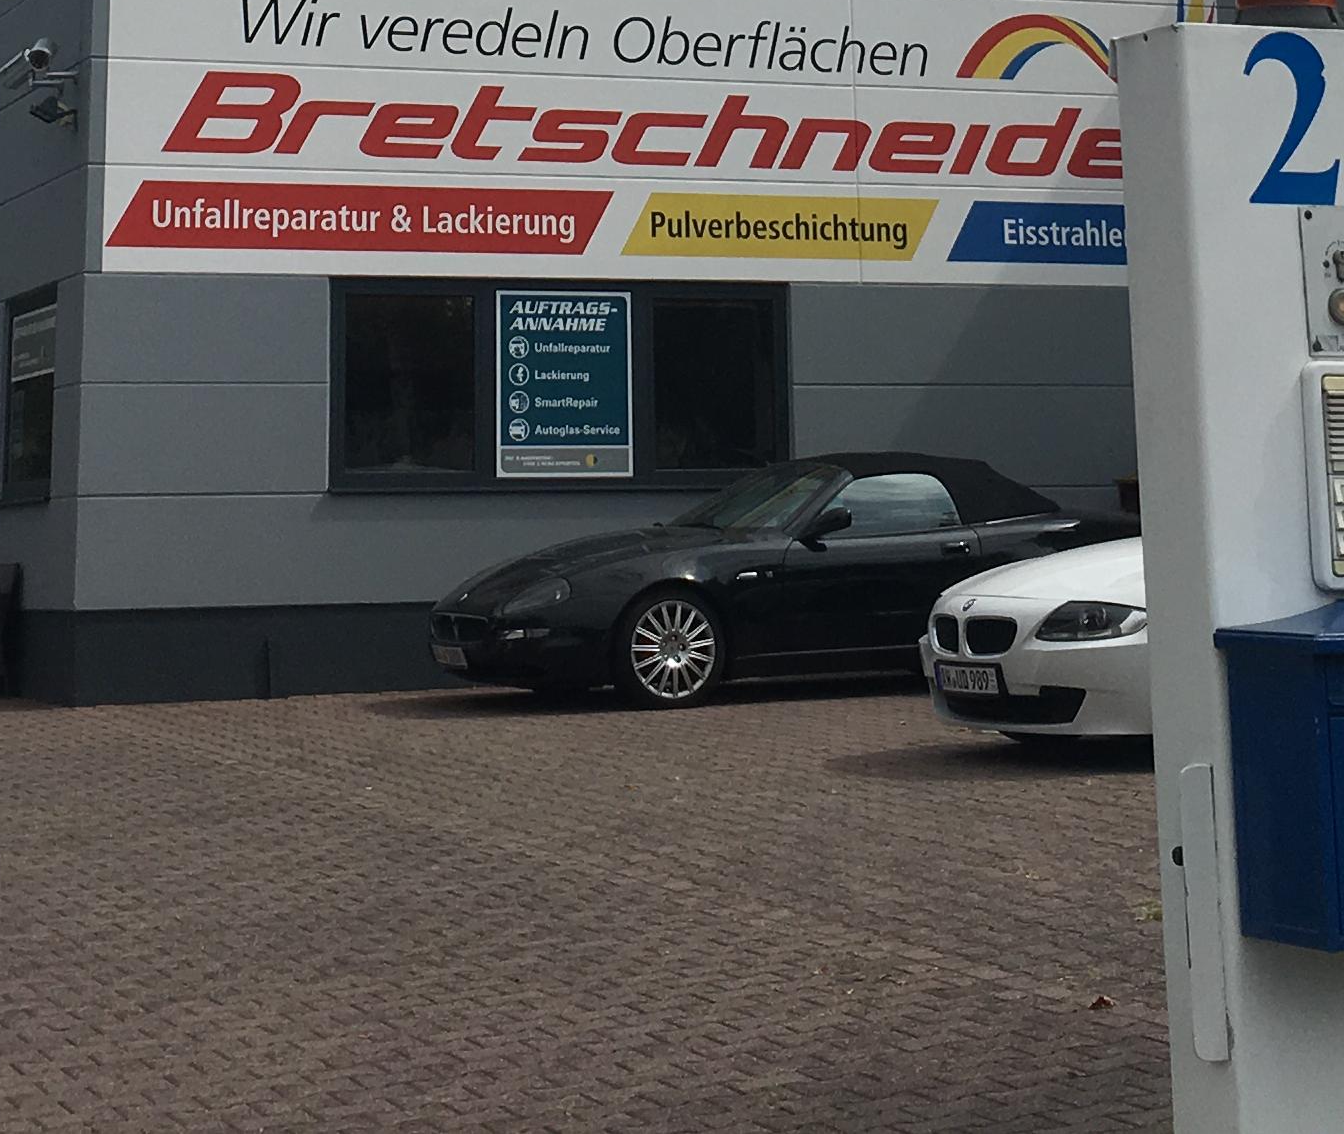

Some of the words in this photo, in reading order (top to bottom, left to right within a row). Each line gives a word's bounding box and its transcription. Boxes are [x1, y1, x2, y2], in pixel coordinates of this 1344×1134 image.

[360, 7, 589, 60] veredeln
[613, 16, 929, 77] Oberflächen
[161, 70, 1124, 179] Bretschneide
[151, 199, 380, 237] Unfallreparatur
[391, 205, 412, 234] &
[422, 206, 576, 244] Lackierung
[649, 211, 909, 250] Pulverbeschichtung
[1002, 218, 1127, 247] Eisstrahle
[509, 300, 618, 316] AUFTRAGS-
[509, 317, 607, 332] ANNAHME
[534, 342, 610, 354] Unfallreparatur
[534, 369, 590, 382] Lackierung
[534, 396, 599, 409] SmartRepair
[534, 424, 621, 438] Autoglas-Service
